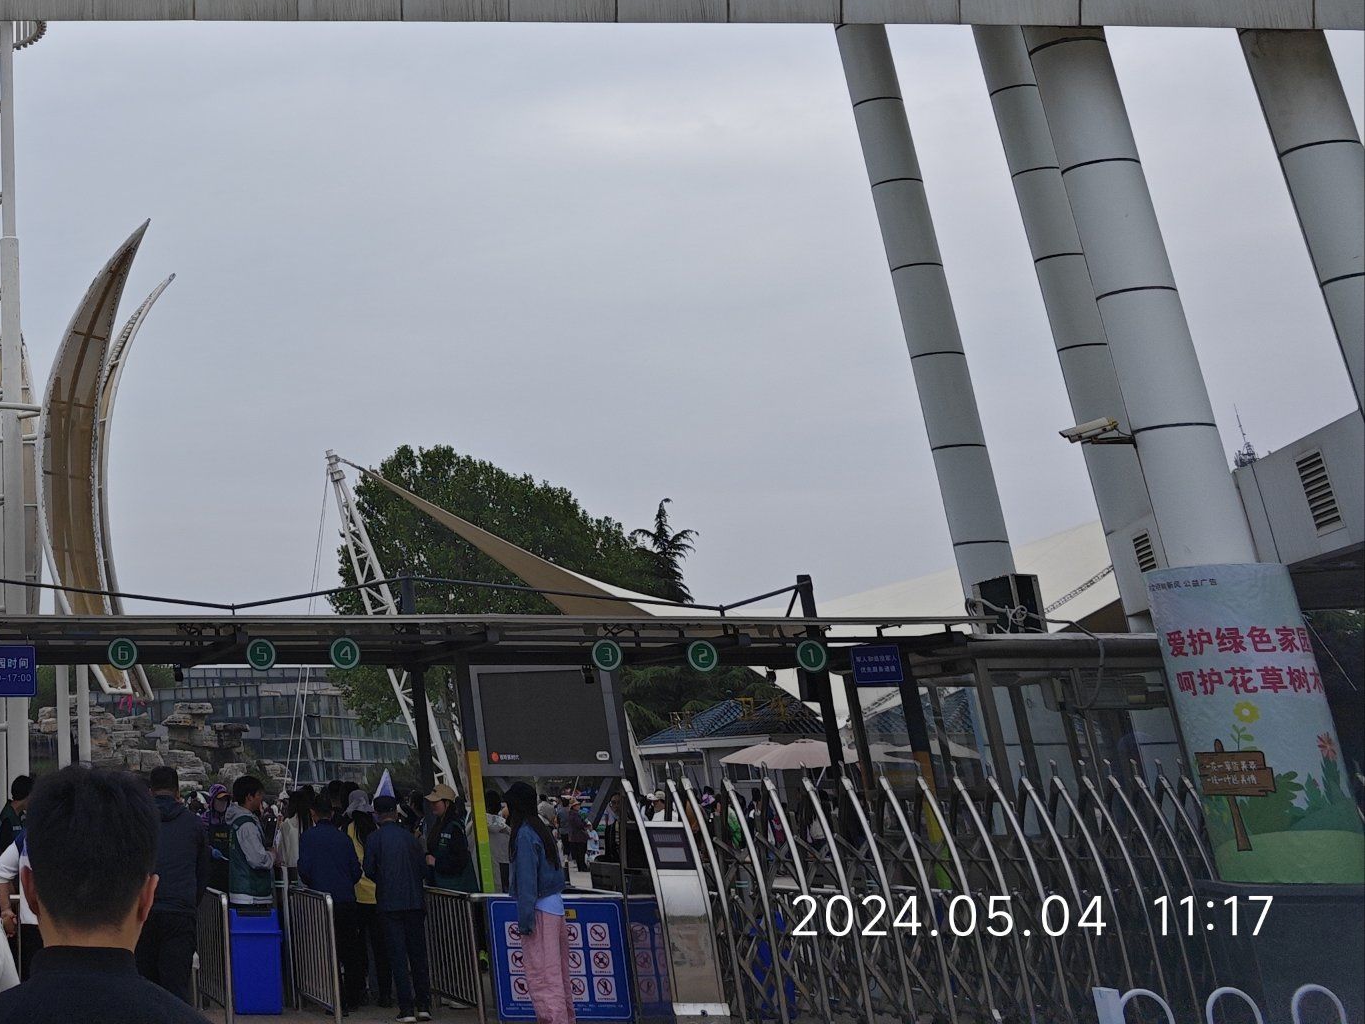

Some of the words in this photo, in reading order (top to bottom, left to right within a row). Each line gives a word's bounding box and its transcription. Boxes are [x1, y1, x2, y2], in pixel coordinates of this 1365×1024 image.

[1183, 578, 1218, 588] 公益广告
[1166, 626, 1313, 658] 爱护绿色家园
